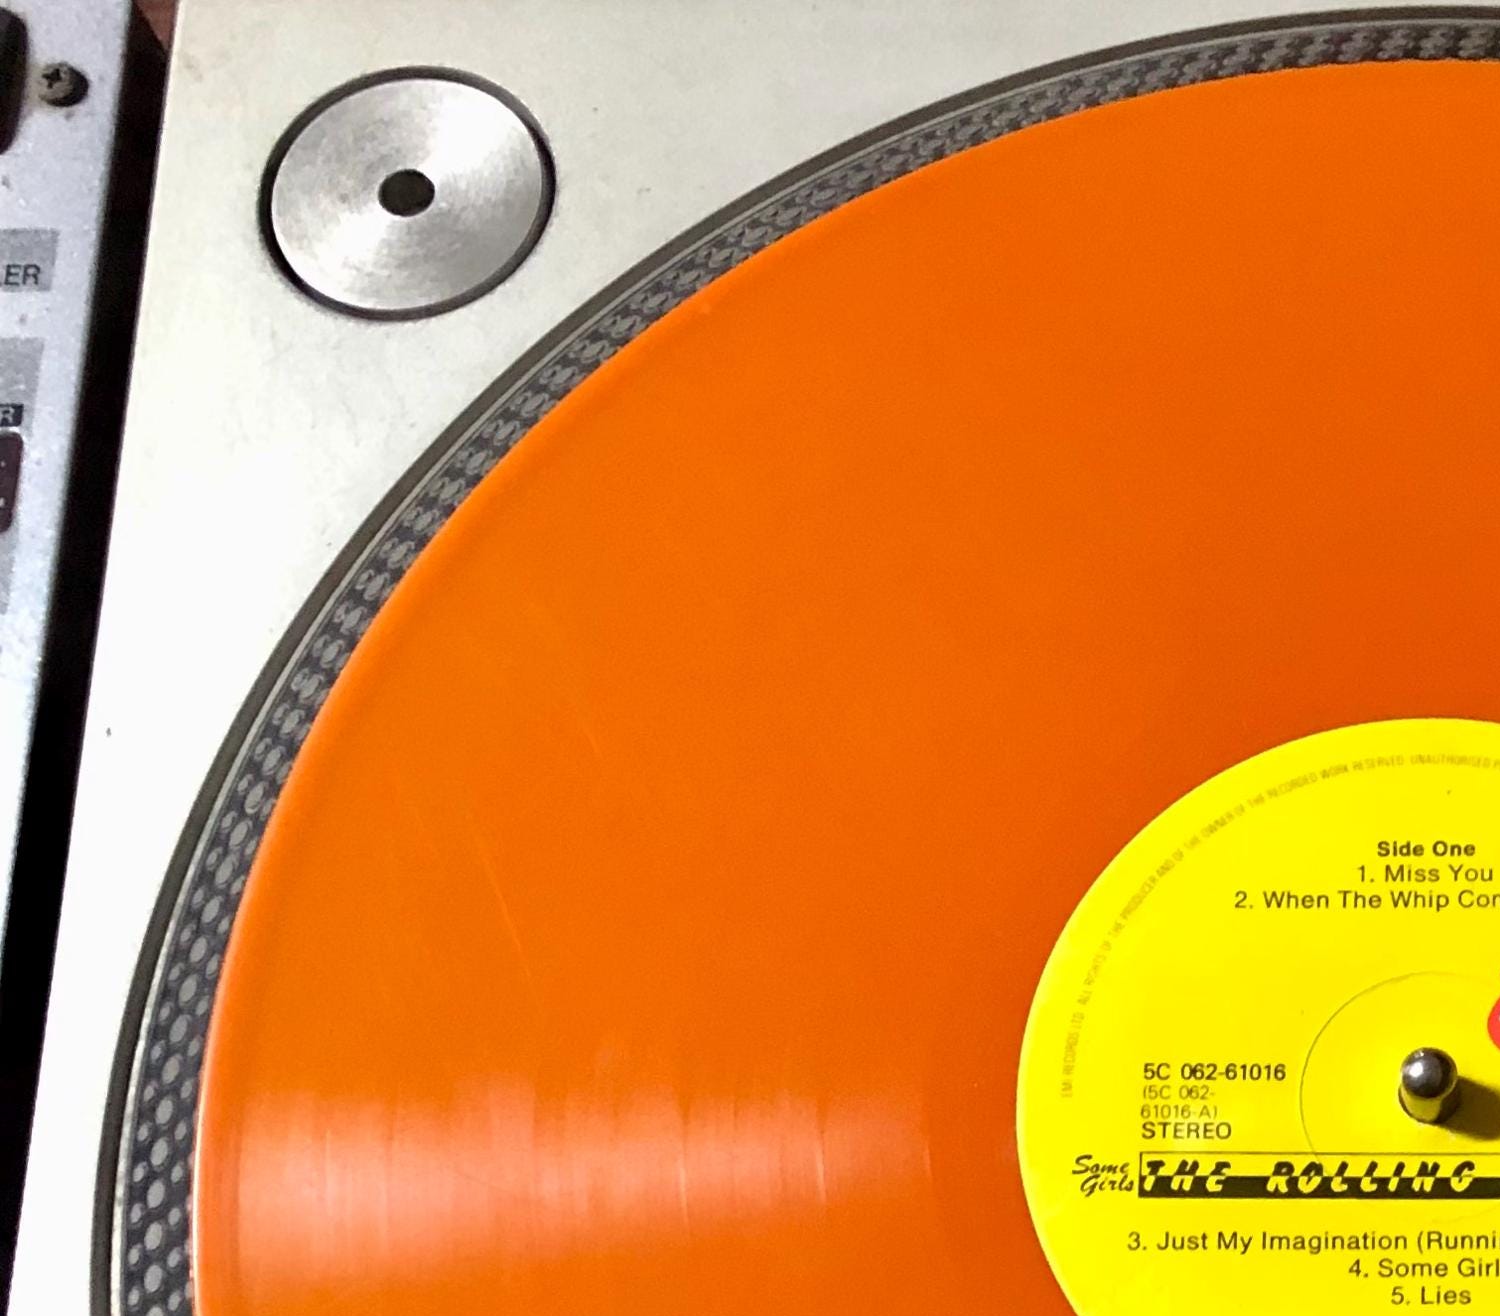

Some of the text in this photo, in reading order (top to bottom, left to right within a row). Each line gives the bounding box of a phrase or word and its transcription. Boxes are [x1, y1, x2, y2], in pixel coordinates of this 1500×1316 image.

[0, 263, 41, 287] ER
[1377, 839, 1476, 858] Side One
[1357, 863, 1494, 884] 1. Miss You
[1234, 889, 1254, 910] 2.
[1262, 890, 1330, 910] When
[1337, 889, 1383, 910] The
[1389, 889, 1450, 913] Whip
[1143, 1062, 1287, 1082] 5C 062-61016
[1142, 1083, 1215, 1102] (5C 062-
[1139, 1103, 1218, 1121] 61016-A)
[1141, 1120, 1232, 1141] STEREO
[1072, 1154, 1130, 1175] Some
[1080, 1174, 1134, 1197] Girls
[1143, 1159, 1232, 1193] THE
[1265, 1160, 1476, 1194] ROLLING
[1127, 1230, 1148, 1252] 3.
[1156, 1230, 1209, 1252] Just
[1217, 1230, 1254, 1256] My
[1261, 1230, 1408, 1256] Imagination
[1348, 1258, 1369, 1279] 4.
[1377, 1257, 1449, 1279] Some
[1390, 1285, 1472, 1306] 5. Lies
